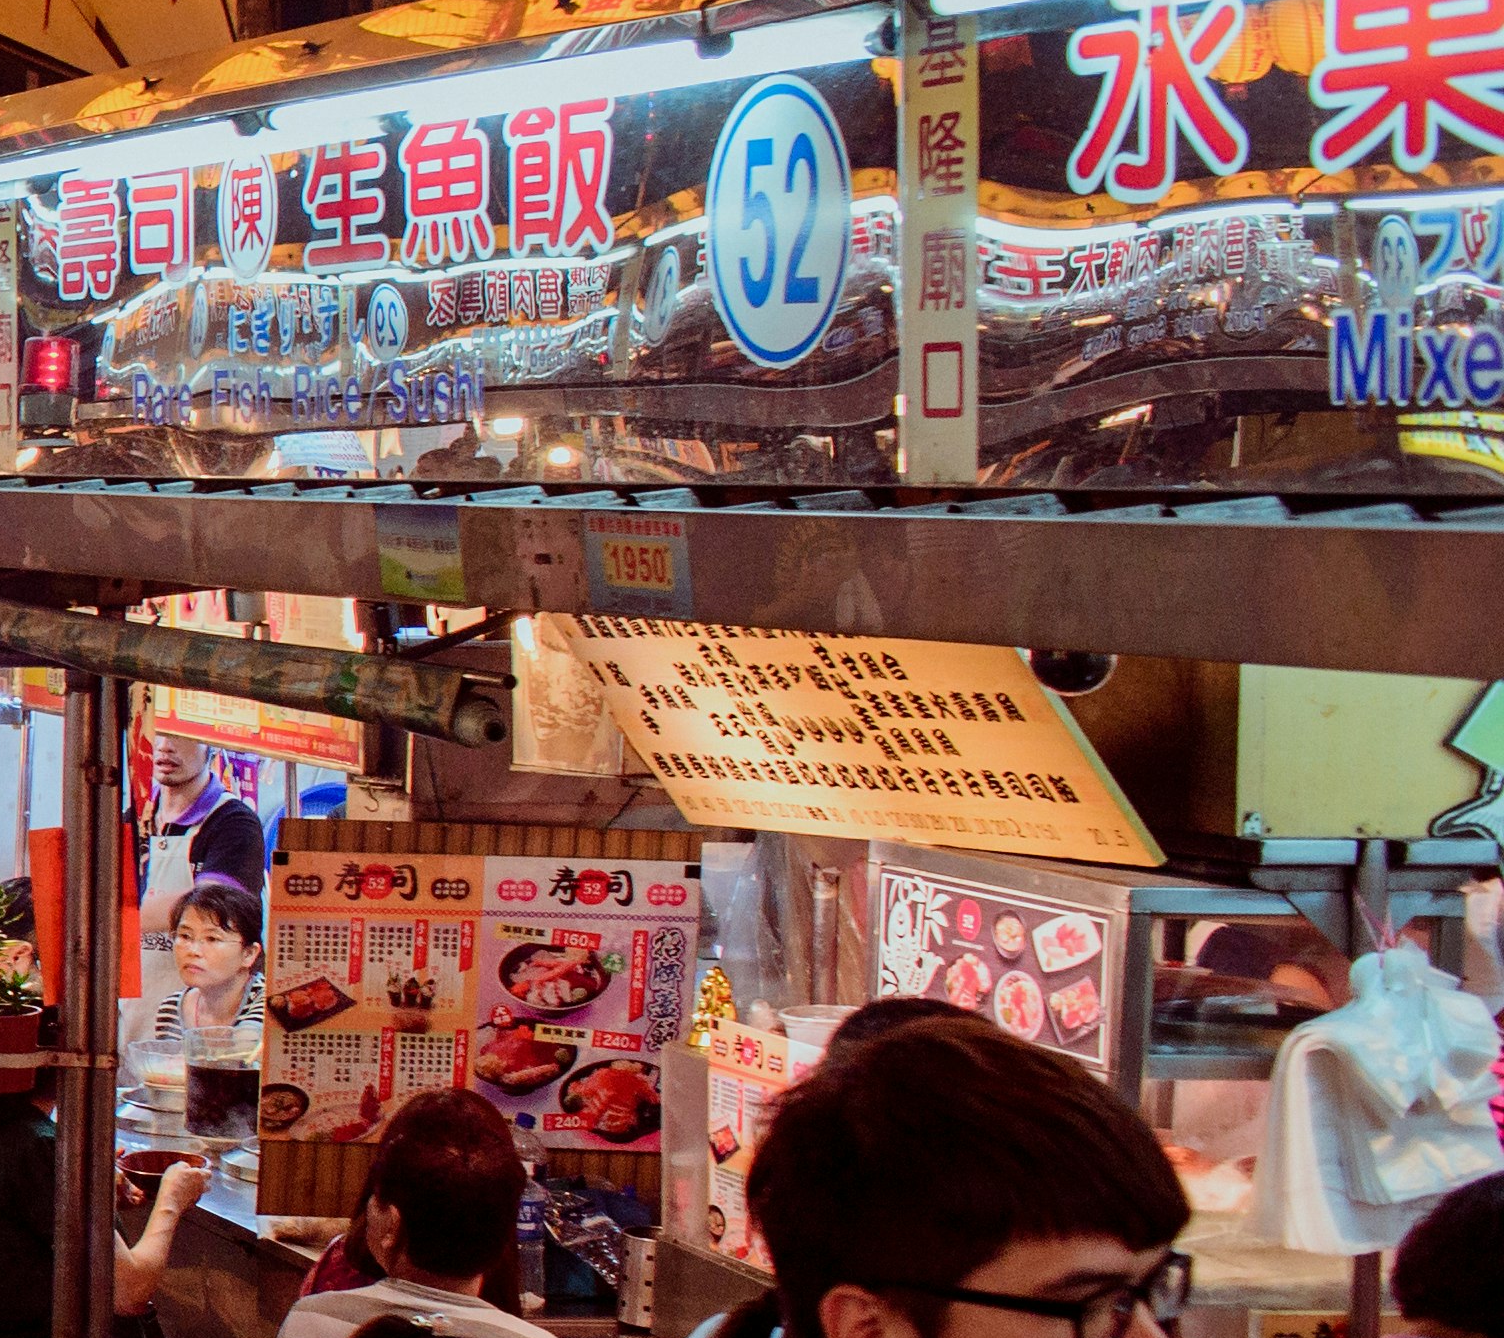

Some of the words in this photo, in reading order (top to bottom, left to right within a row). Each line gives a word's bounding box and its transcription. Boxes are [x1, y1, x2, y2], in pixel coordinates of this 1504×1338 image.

[303, 99, 615, 274] 生魚飯
[740, 133, 822, 309] 52
[133, 372, 192, 427] Rare
[211, 367, 272, 423] Fish
[293, 365, 364, 423] Rice
[387, 359, 485, 421] Sushi
[608, 541, 669, 585] 1950
[367, 879, 386, 890] 52
[583, 883, 602, 896] 52
